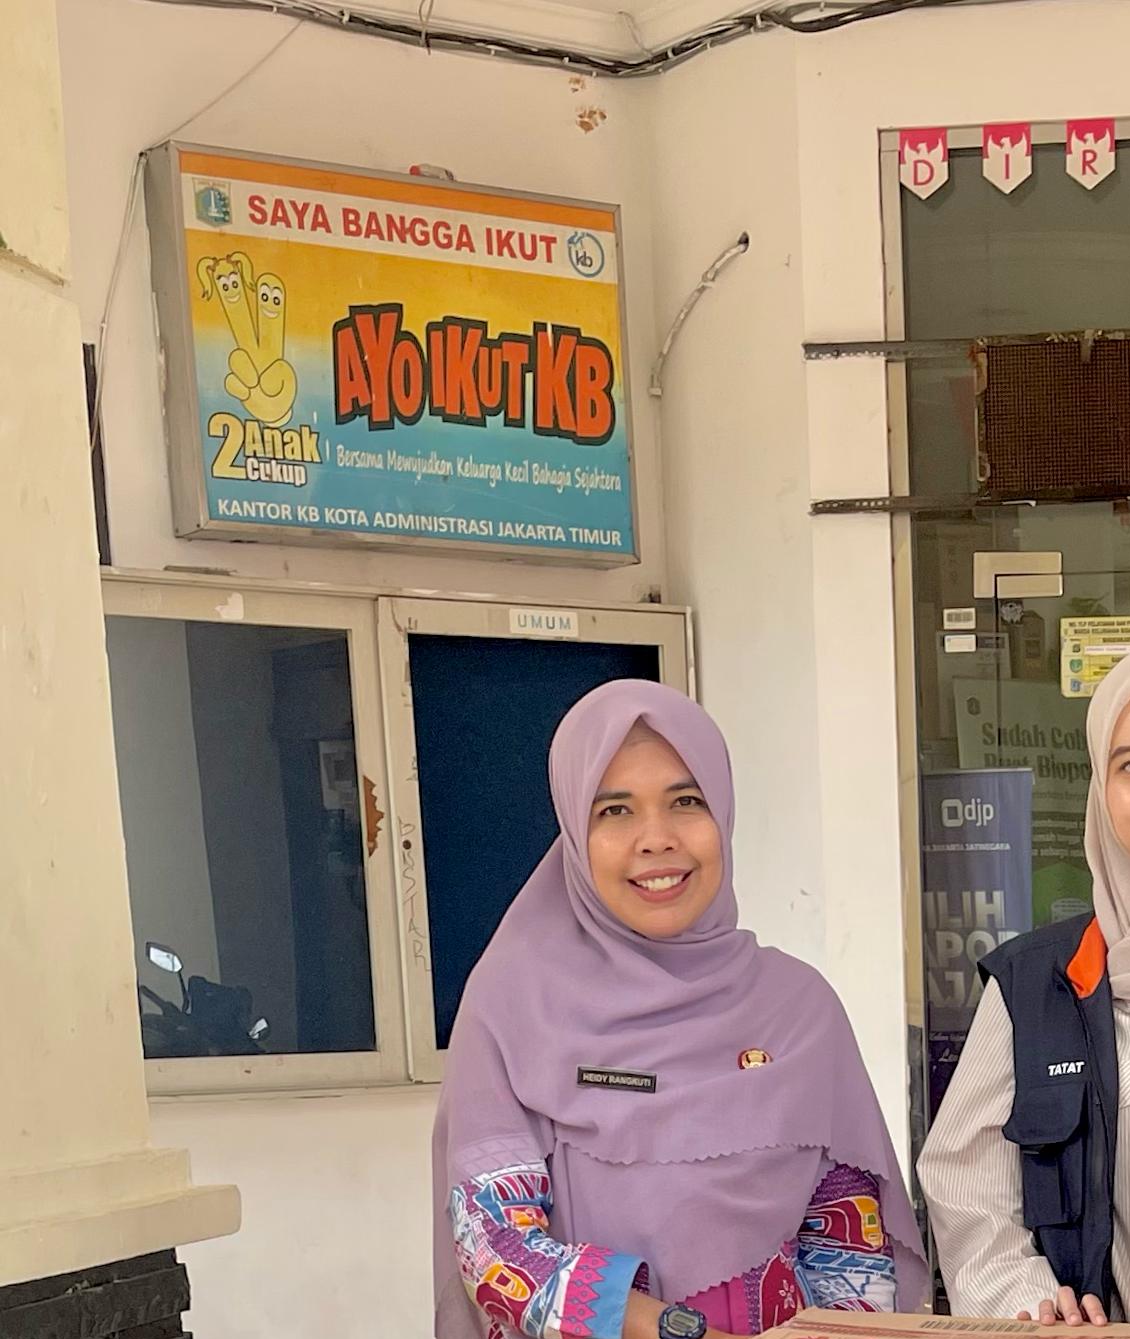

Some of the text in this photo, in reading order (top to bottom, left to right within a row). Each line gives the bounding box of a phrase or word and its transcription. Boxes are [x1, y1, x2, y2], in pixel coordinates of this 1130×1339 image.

[248, 195, 557, 263] SAYA BANGGA IKUT
[335, 307, 612, 441] AYO IKUT KB
[209, 412, 321, 480] 2 Anak
[246, 458, 307, 487] Cukup
[336, 445, 621, 495] Bersama Mewujudkan Keluarga Kecil Bahagia Sejahtera
[217, 499, 622, 546] KANTOR KB KOTA ADMINISTRASI JAKARTA TIMUR
[517, 614, 571, 630] UMUM
[1037, 756, 1090, 780] Biopo
[964, 798, 994, 826] djp
[923, 890, 1005, 929] ILIH
[1048, 1062, 1084, 1075] TATAT
